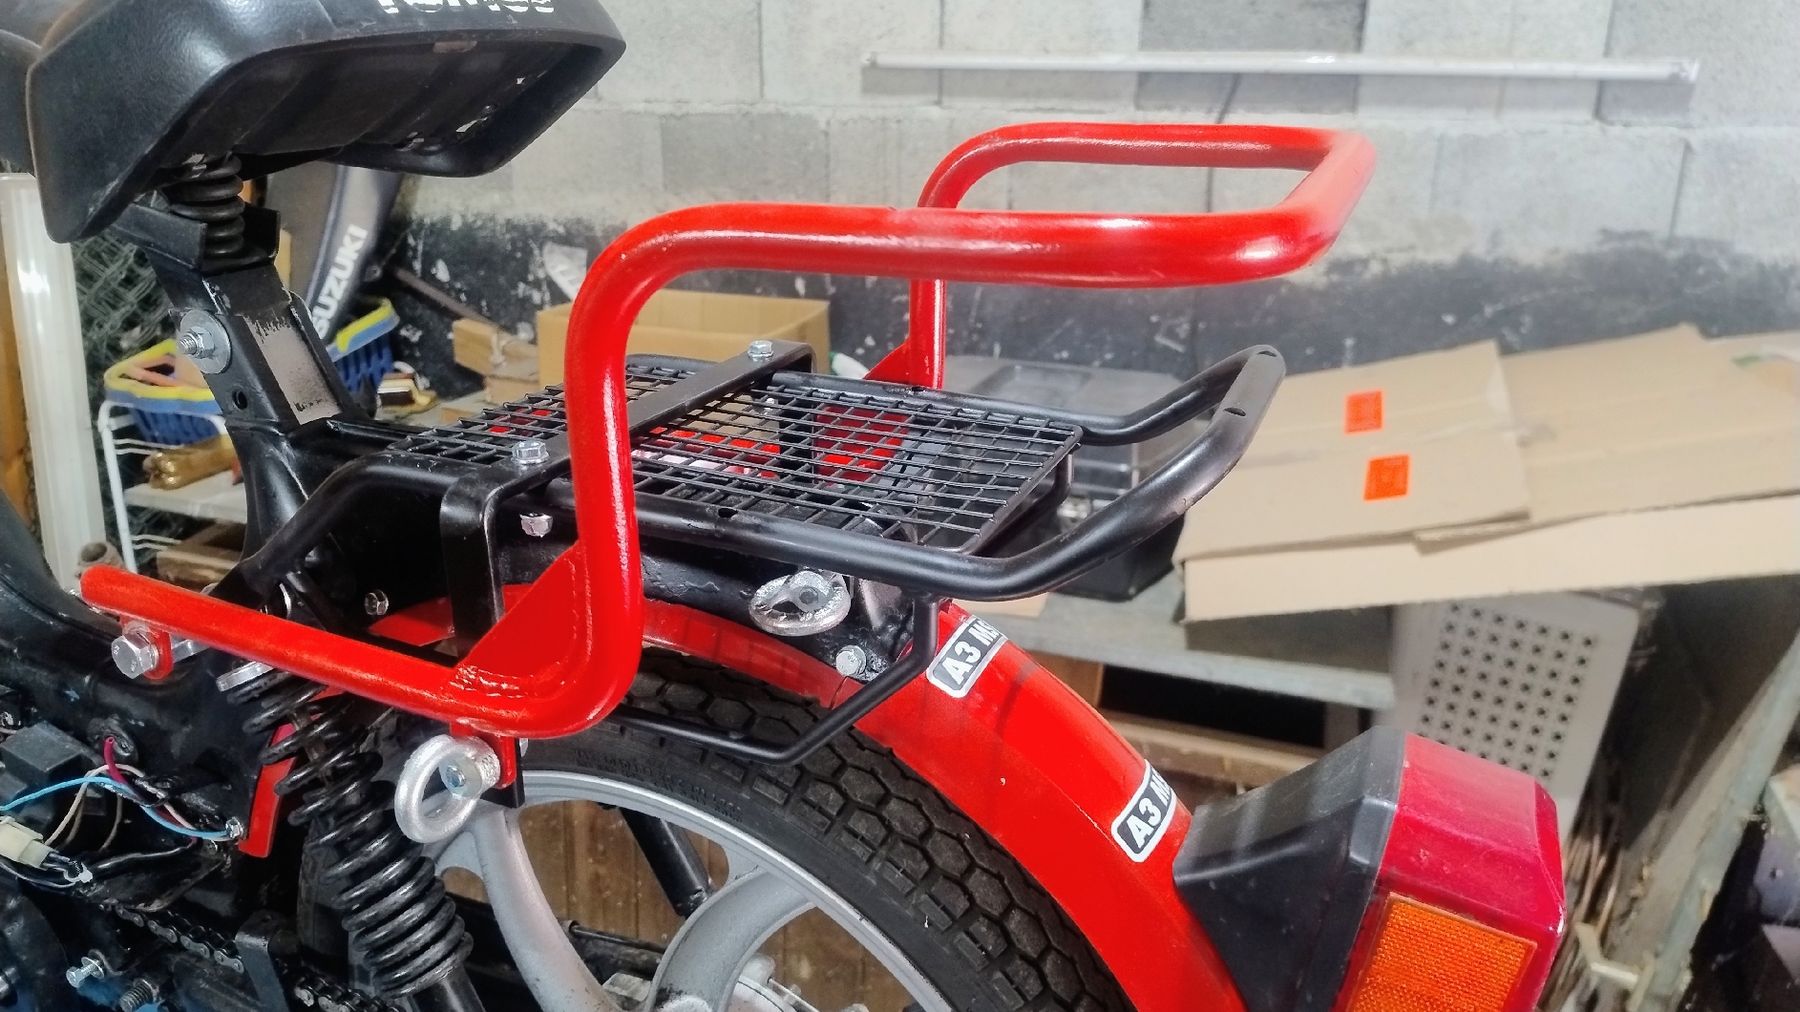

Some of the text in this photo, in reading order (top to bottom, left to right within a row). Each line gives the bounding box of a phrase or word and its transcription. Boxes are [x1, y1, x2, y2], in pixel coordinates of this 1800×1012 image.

[311, 224, 368, 339] SUZUKI
[941, 619, 1000, 685] A3 M
[1126, 797, 1162, 849] A3
